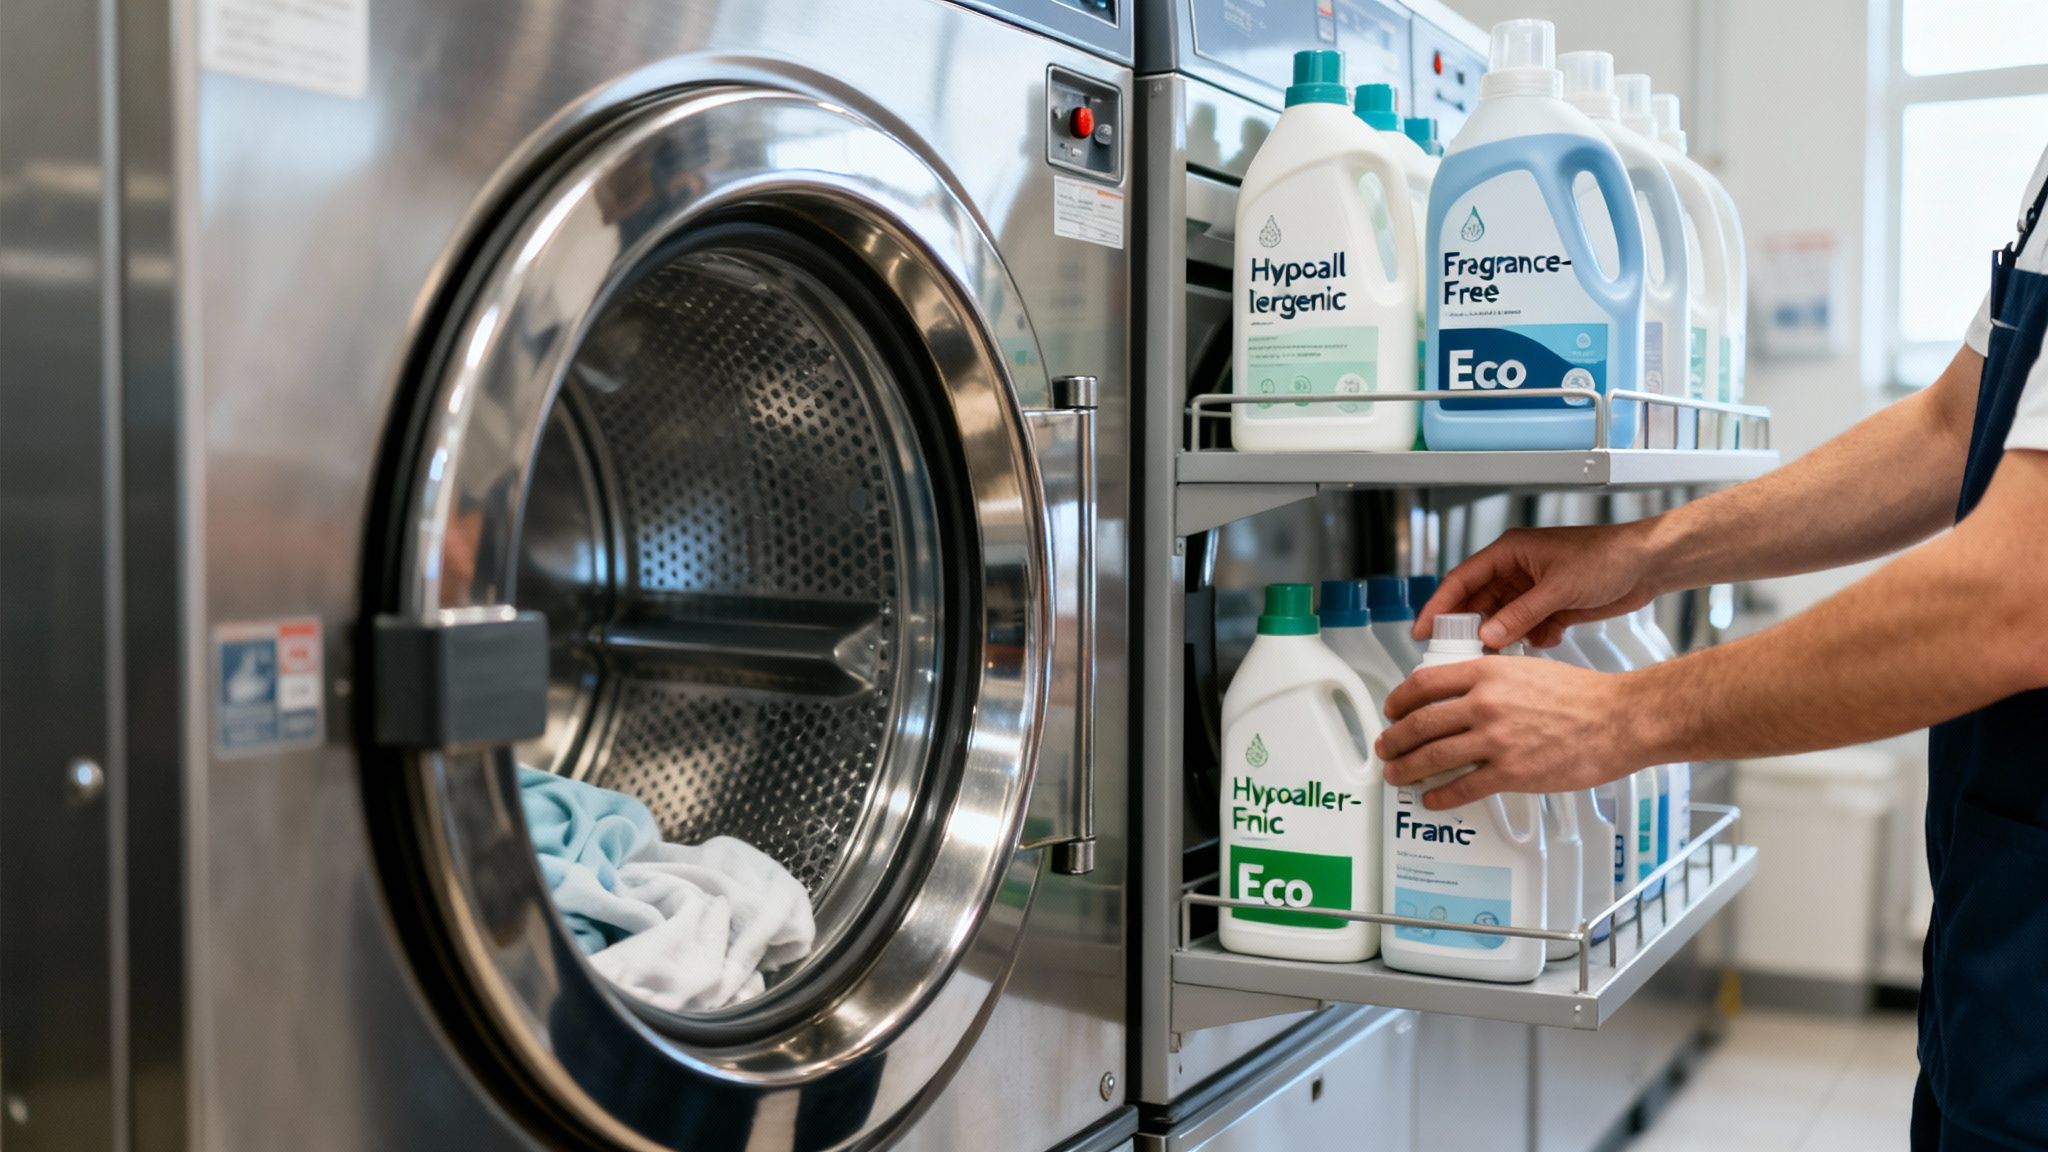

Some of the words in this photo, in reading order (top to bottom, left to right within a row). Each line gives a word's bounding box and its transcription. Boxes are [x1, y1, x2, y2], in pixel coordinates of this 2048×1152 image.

[1251, 251, 1346, 288] Hypoall
[1444, 252, 1572, 281] Fragrance-
[1444, 280, 1499, 305] Free
[1449, 349, 1527, 390] Eco
[1238, 863, 1313, 908] Eco
